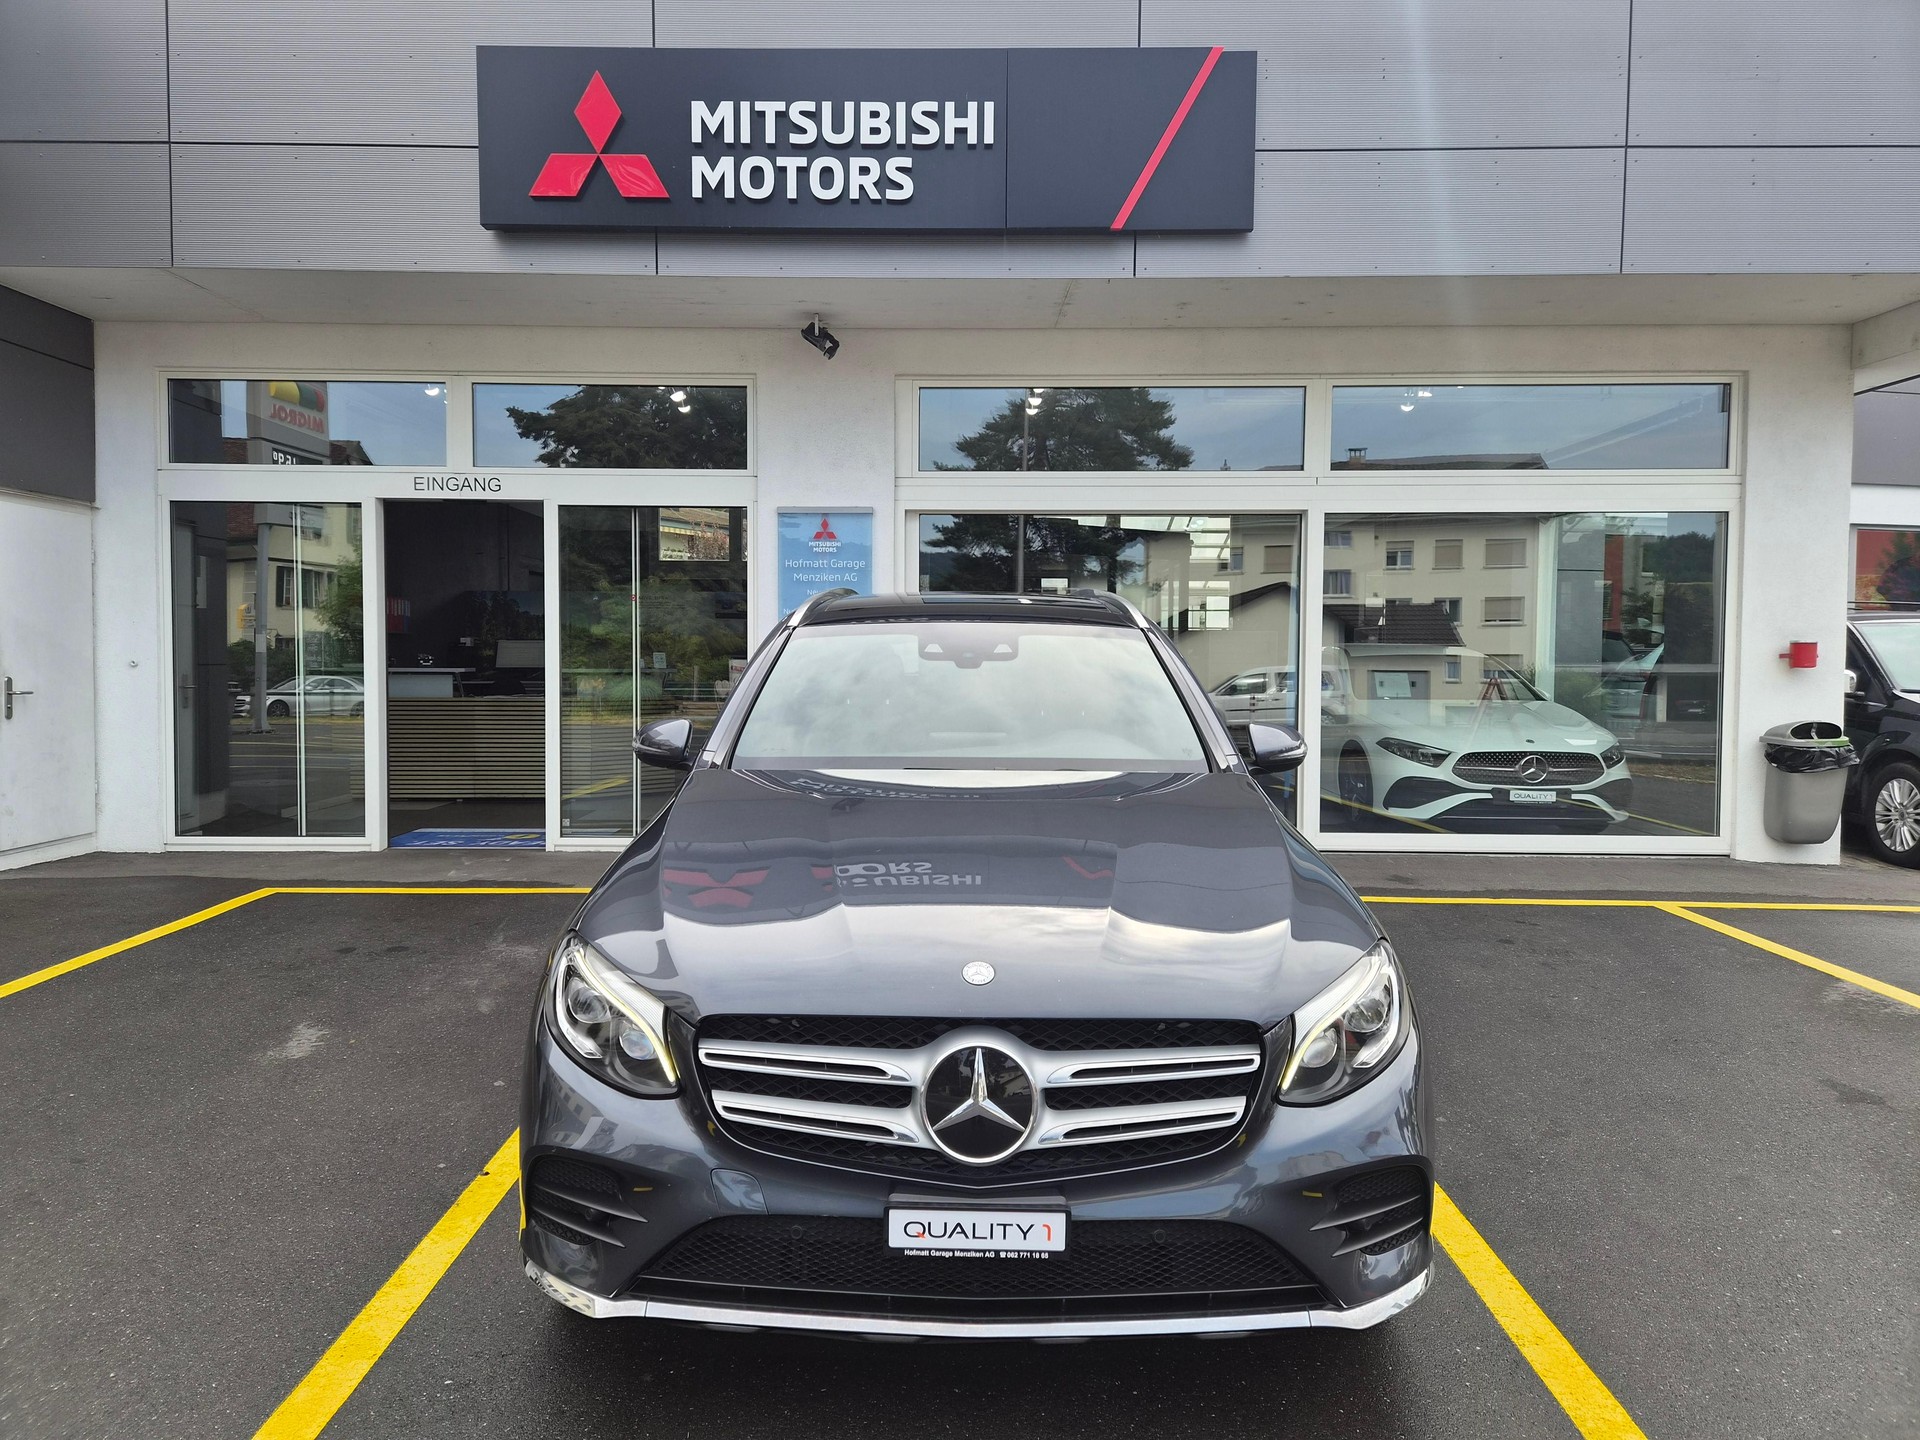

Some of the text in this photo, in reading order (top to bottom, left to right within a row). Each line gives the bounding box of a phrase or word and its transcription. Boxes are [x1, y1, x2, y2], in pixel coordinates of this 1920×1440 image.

[690, 100, 995, 146] MITSUBISHI
[690, 155, 915, 201] MOTORS
[413, 476, 502, 493] EINGANG
[785, 559, 866, 570] Hofmatt Garage
[793, 573, 858, 582] Menziken AG
[903, 1221, 1052, 1241] QUALITY 1
[930, 1250, 953, 1258] Garage
[954, 1250, 984, 1258] Menziken
